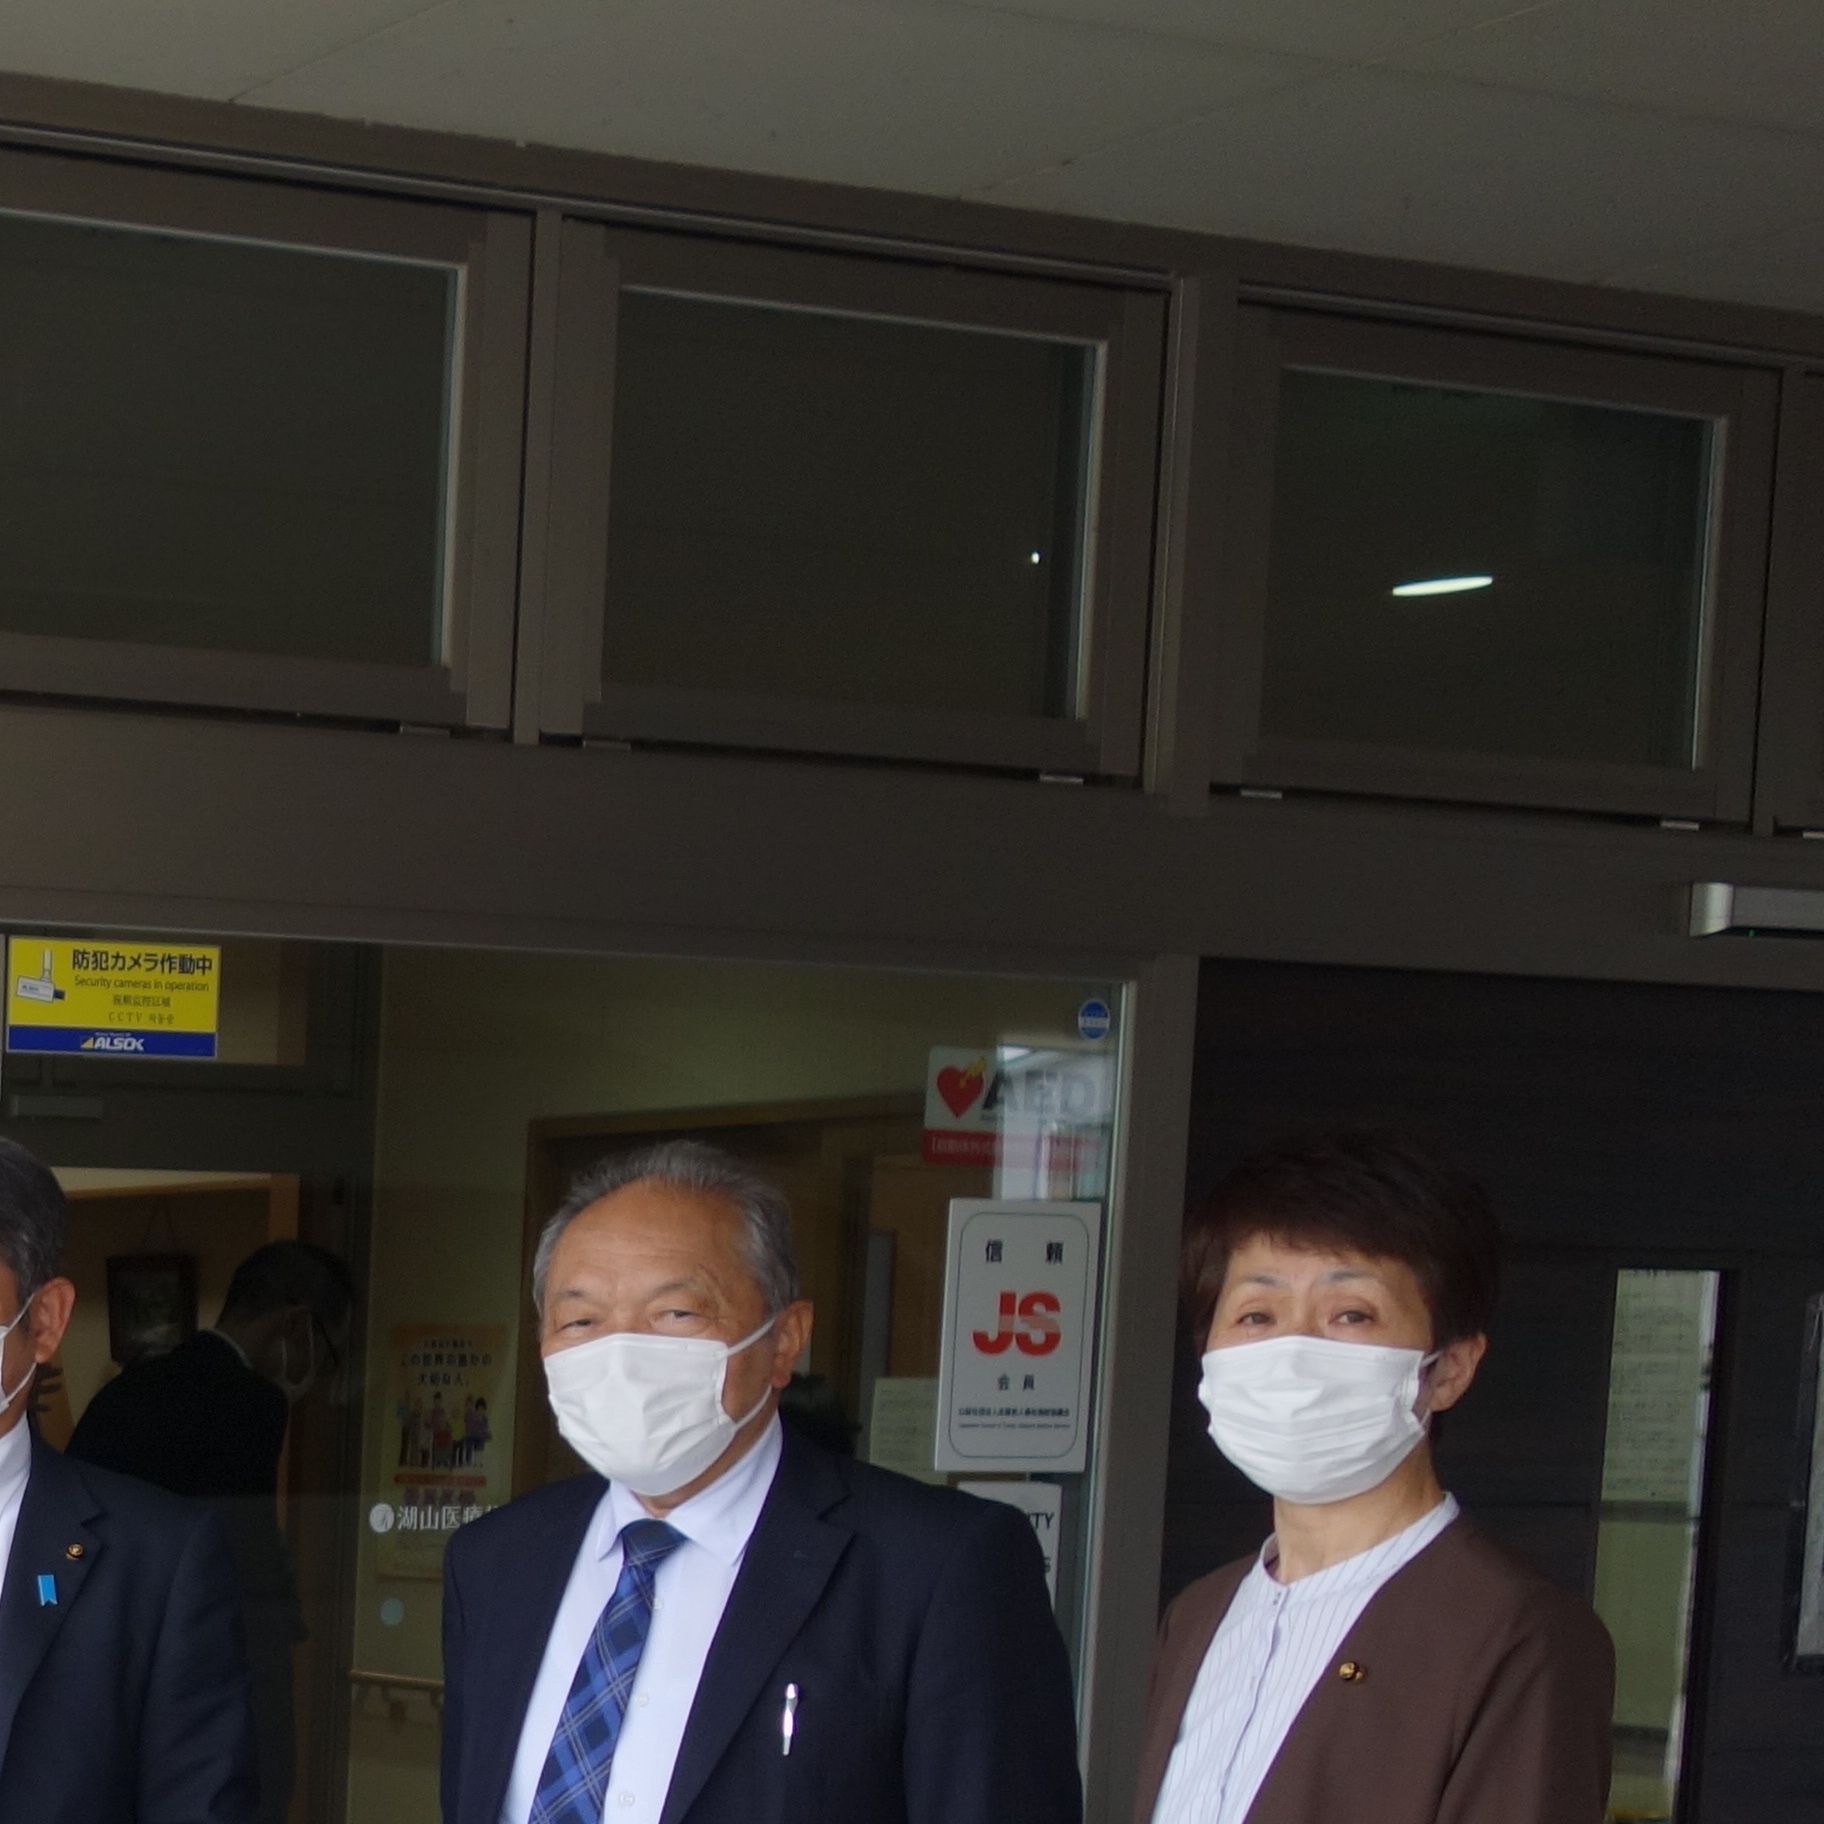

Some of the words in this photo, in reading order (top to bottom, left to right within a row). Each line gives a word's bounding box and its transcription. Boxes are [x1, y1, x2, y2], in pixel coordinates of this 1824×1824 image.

[72, 949, 213, 975] 防犯カメラ作動中
[74, 975, 111, 986] Security
[115, 979, 152, 988] cameras
[155, 980, 163, 988] in
[166, 981, 209, 992] operation
[95, 1038, 144, 1051] ALSOK
[973, 1290, 1062, 1357] JS
